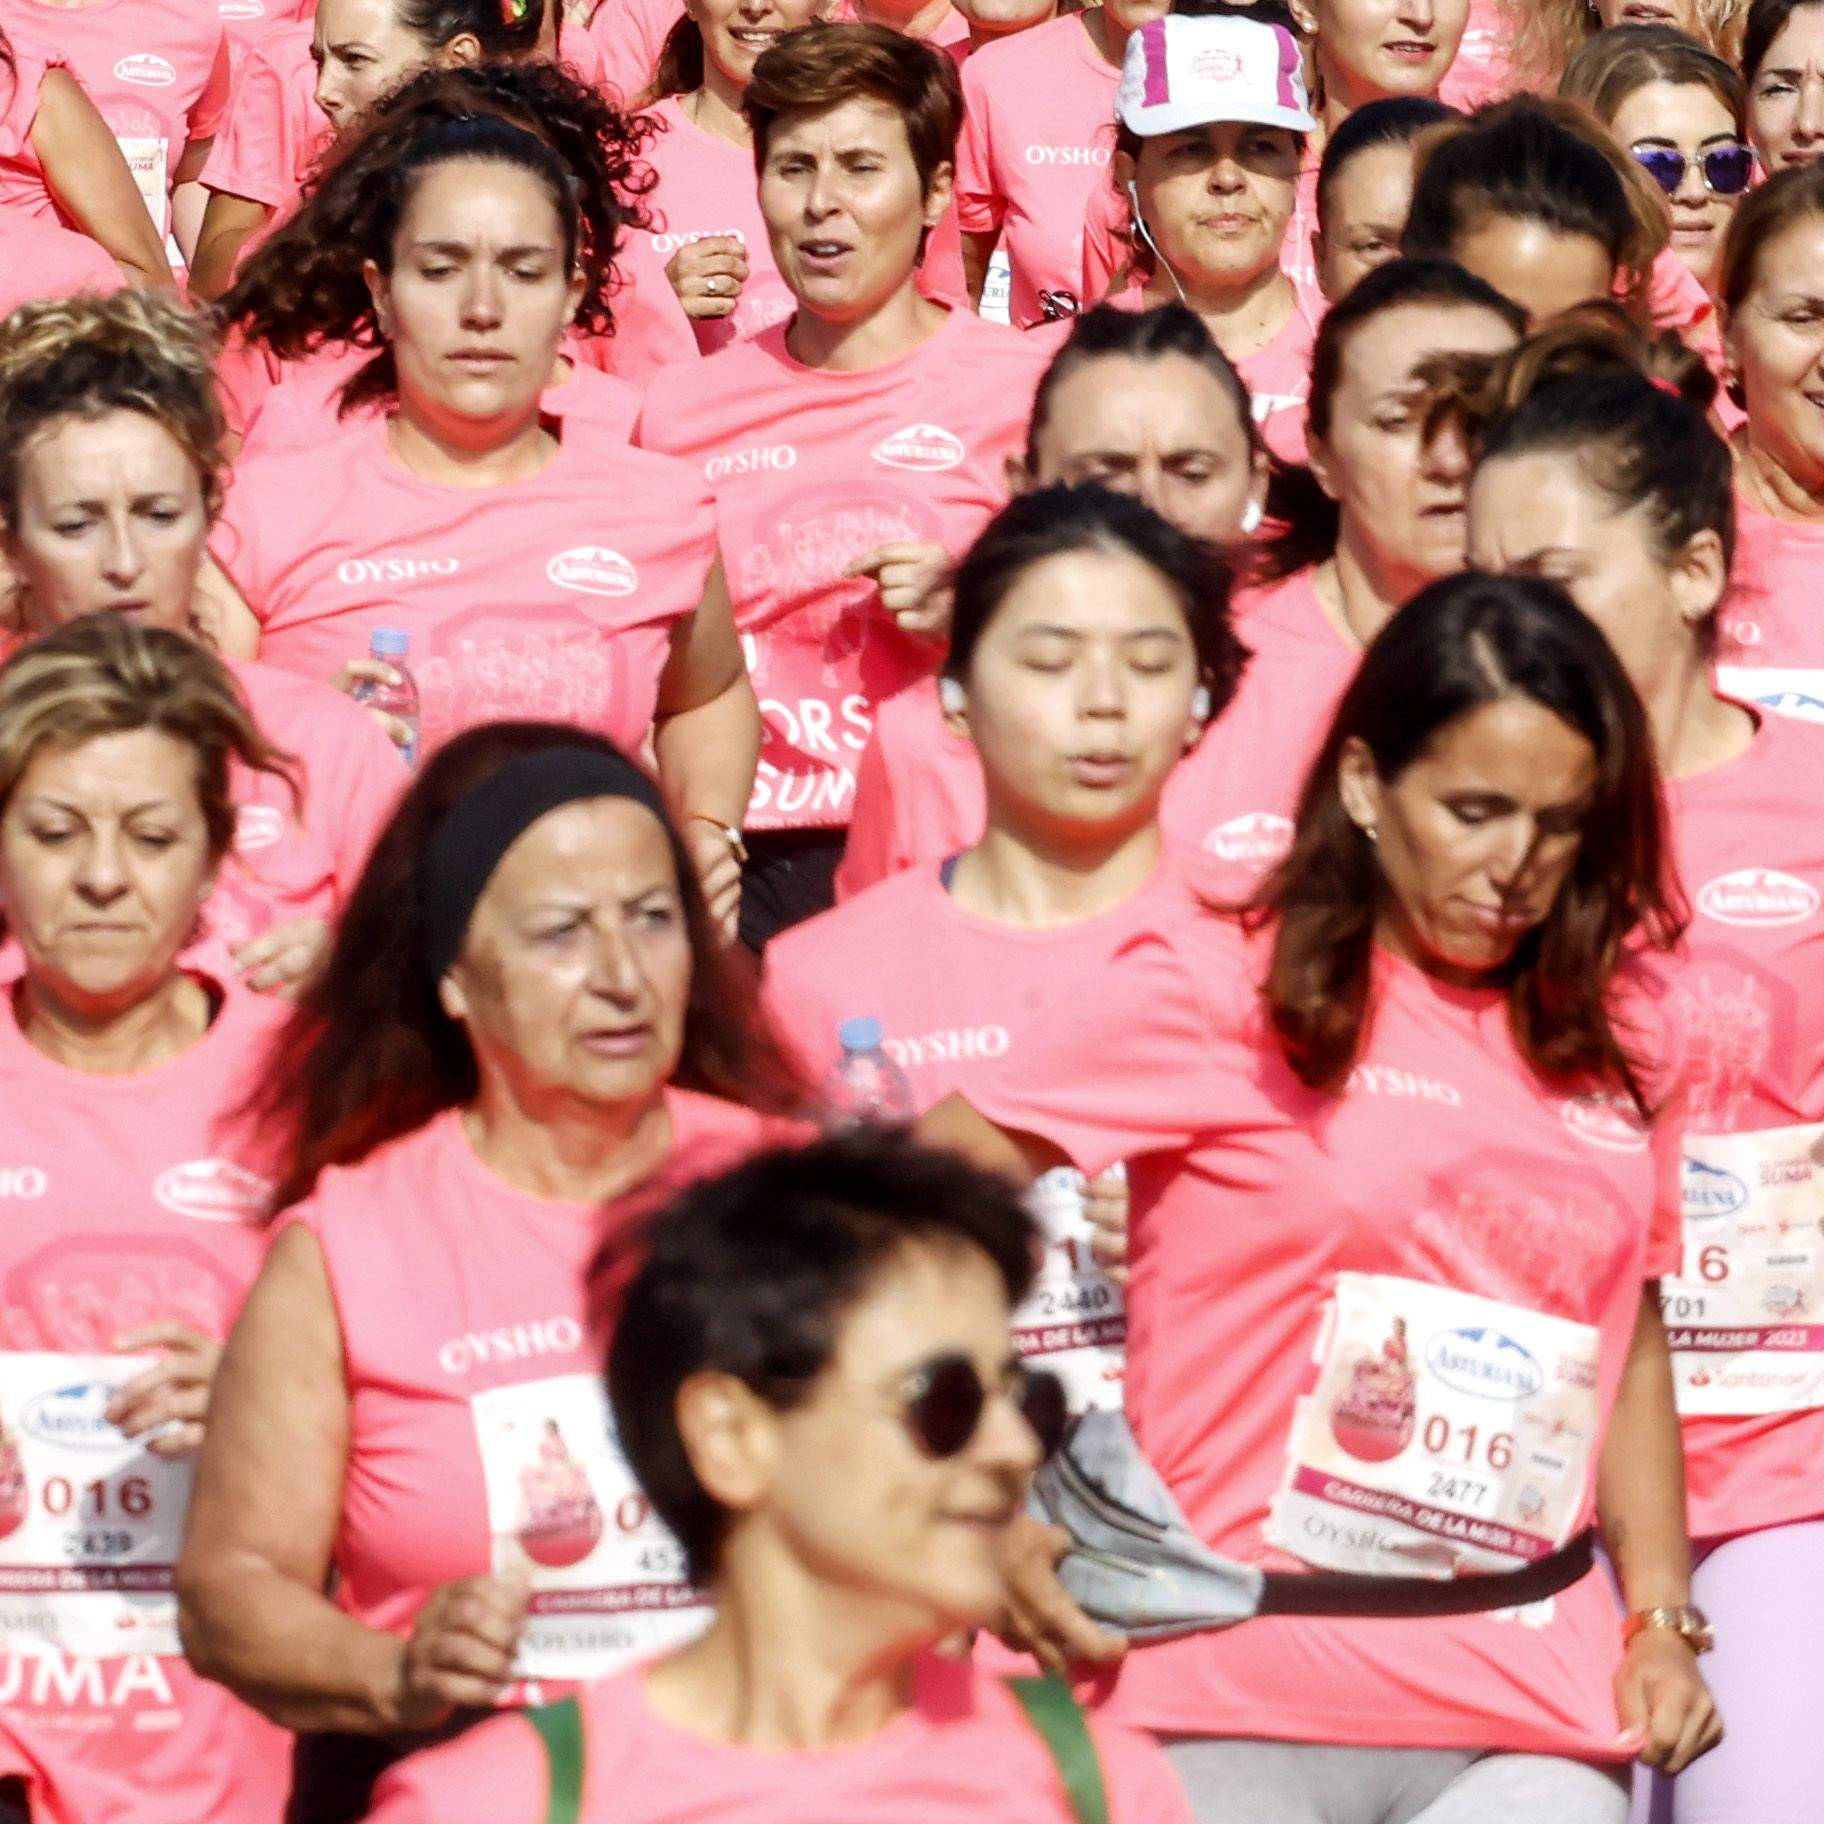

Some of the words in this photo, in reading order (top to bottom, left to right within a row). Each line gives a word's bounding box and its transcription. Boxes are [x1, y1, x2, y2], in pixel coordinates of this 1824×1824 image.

[1025, 142, 1112, 167] OYSHO
[705, 444, 797, 481] OYSHO
[438, 1314, 583, 1376] OYSHO
[1423, 1414, 1515, 1470] 016
[41, 1476, 152, 1517] 016
[1427, 1472, 1488, 1509] 2477
